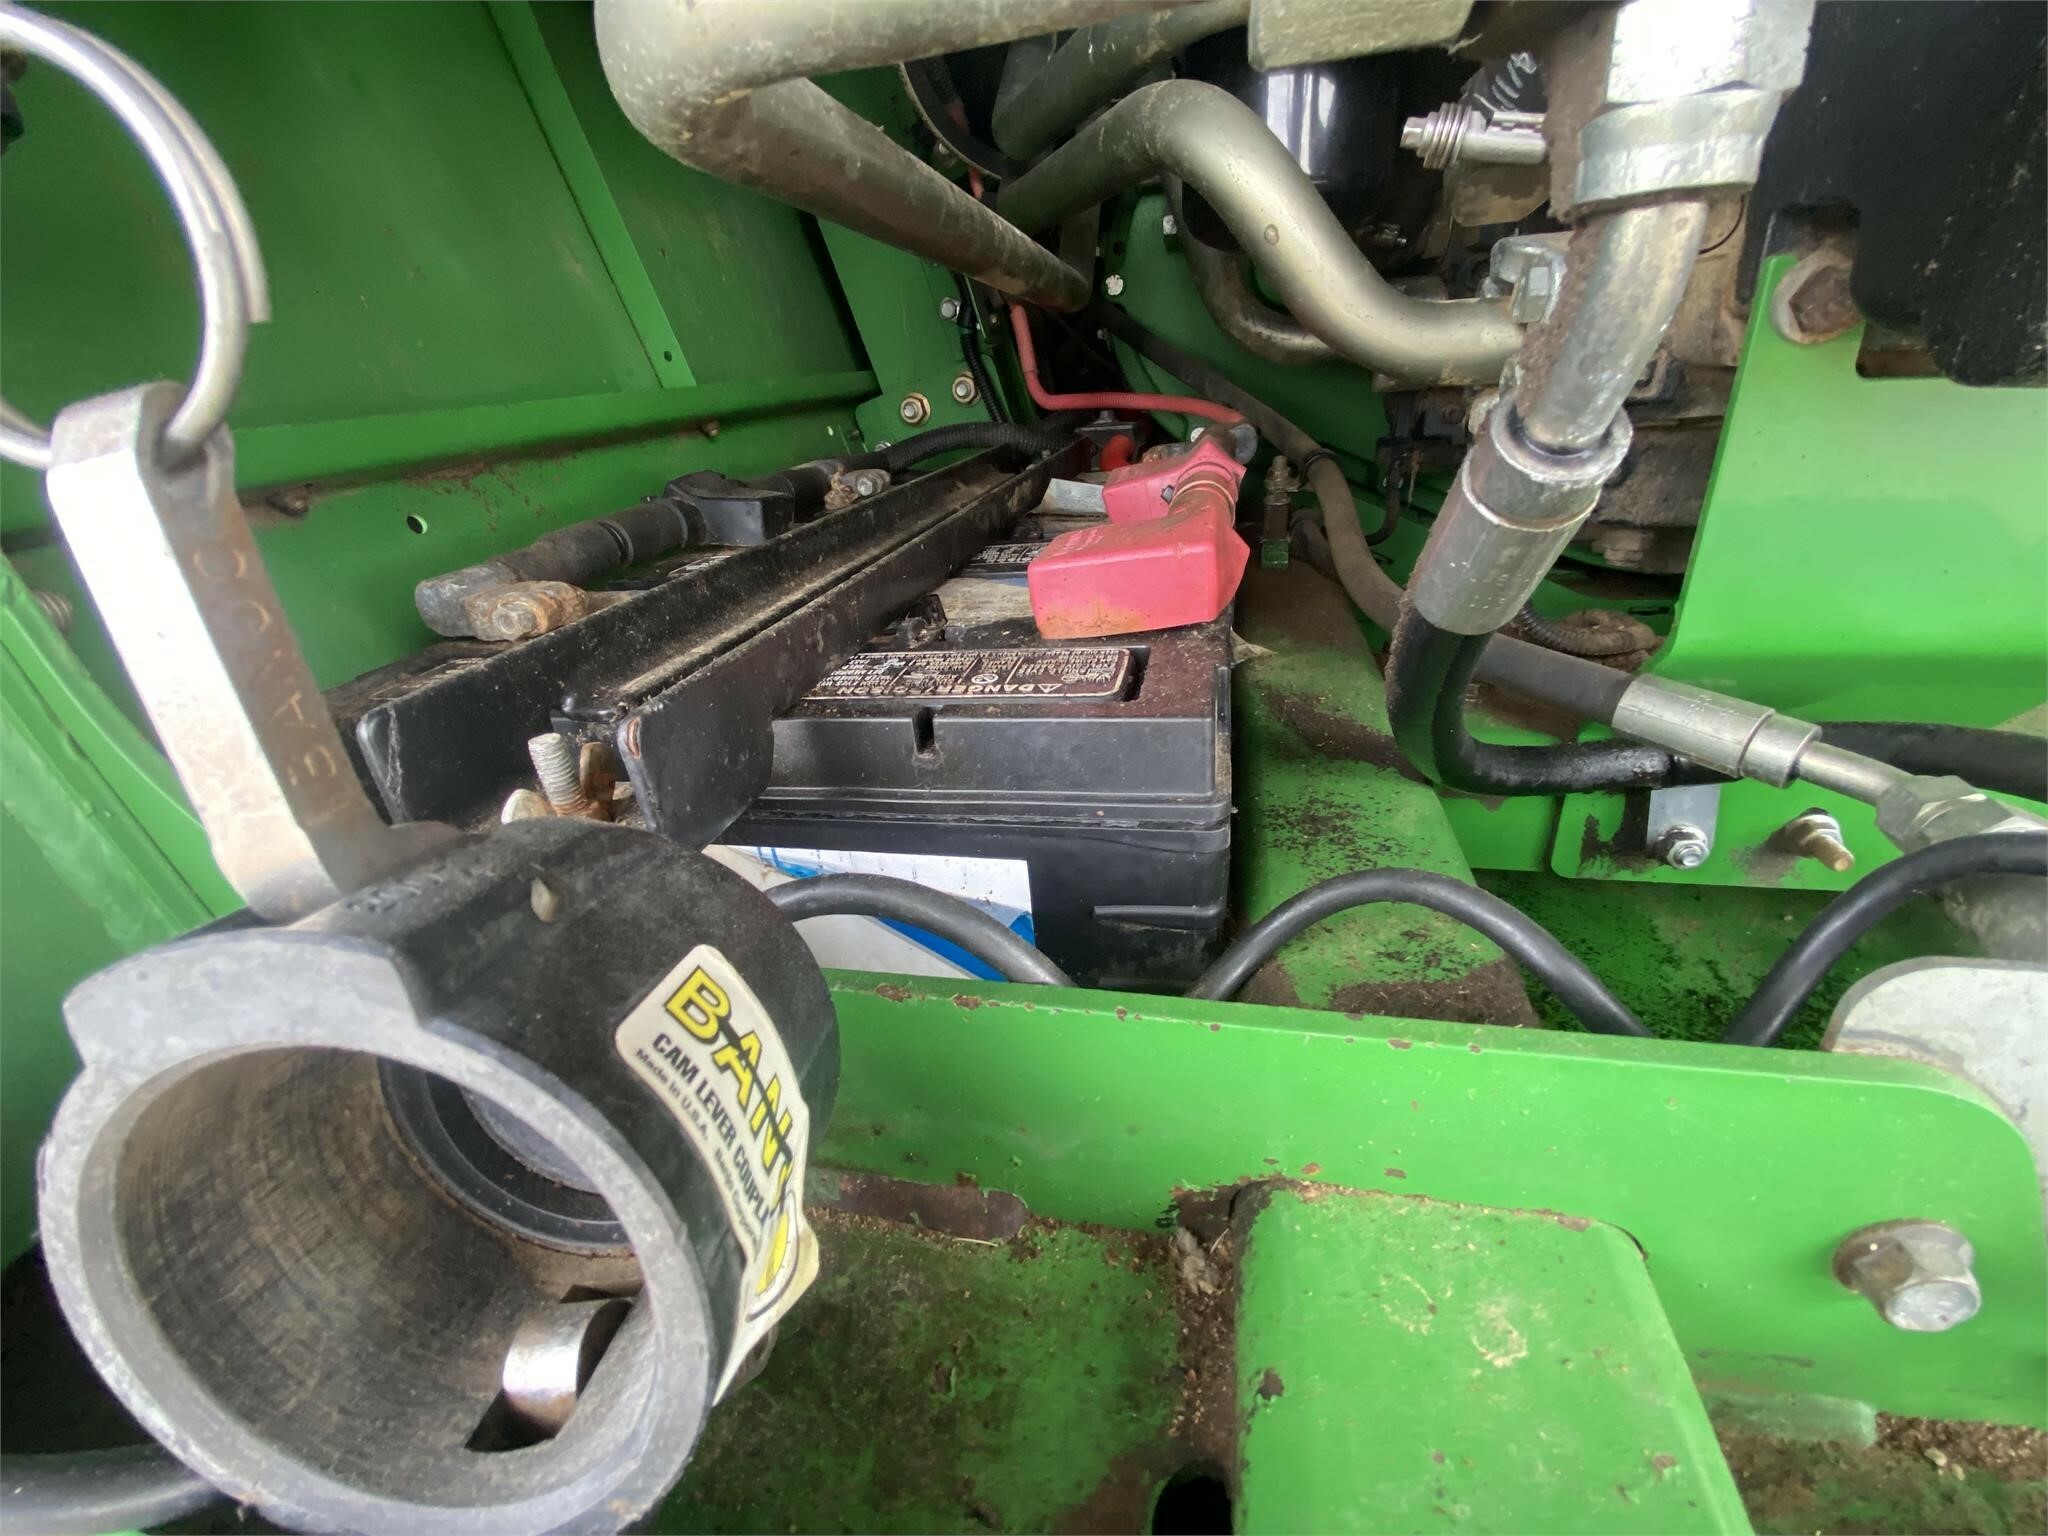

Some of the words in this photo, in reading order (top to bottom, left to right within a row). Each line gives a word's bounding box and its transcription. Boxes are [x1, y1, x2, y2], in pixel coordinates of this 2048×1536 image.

[634, 1047, 670, 1086] Made
[667, 1080, 682, 1099] in
[679, 1093, 710, 1143] U.S.A.
[651, 1031, 699, 1086] CAM
[696, 1067, 736, 1152] LEVER
